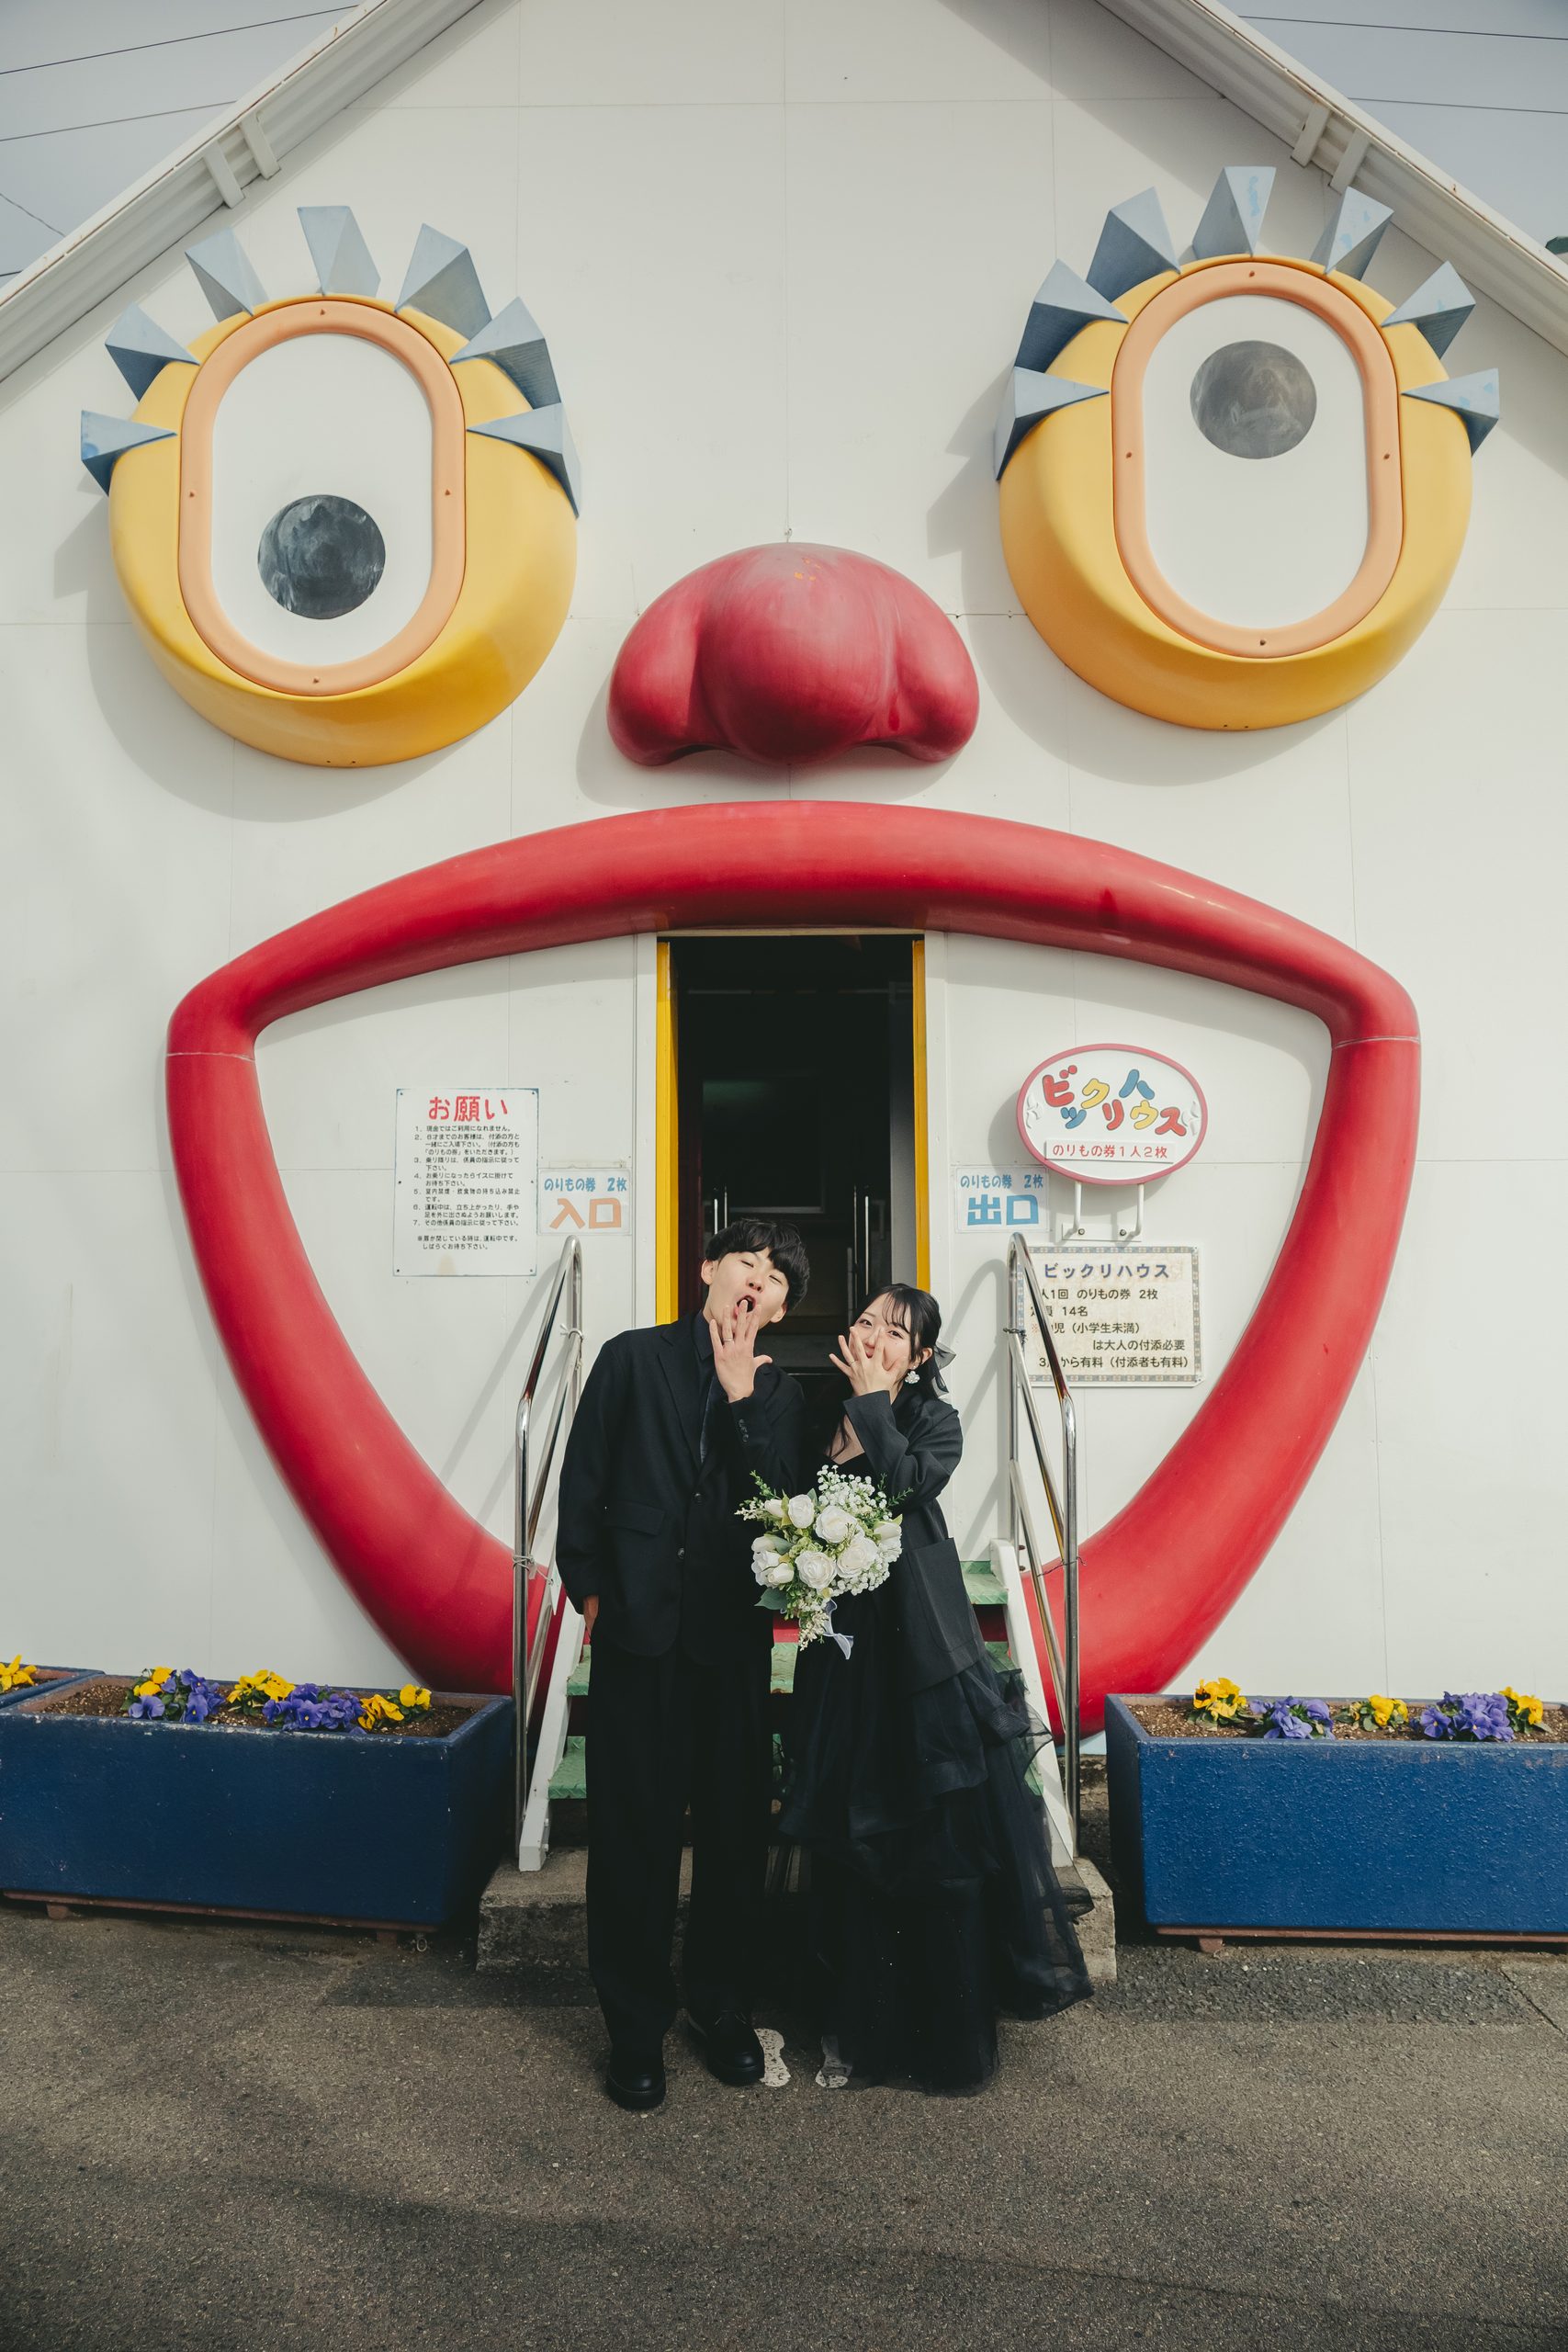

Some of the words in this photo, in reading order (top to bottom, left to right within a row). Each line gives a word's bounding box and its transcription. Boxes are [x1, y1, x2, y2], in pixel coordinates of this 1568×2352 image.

[428, 1095, 508, 1122] お願い
[1052, 1144, 1168, 1159] のりもの券1人2枚
[544, 1177, 596, 1193] のりもの券
[607, 1177, 627, 1193] 2枚
[960, 1174, 1012, 1189] のりもの券
[1023, 1173, 1044, 1189] 2枚
[549, 1197, 622, 1229] 入口
[967, 1193, 1040, 1227] 出口
[1044, 1262, 1170, 1280] ビックリハウス
[1076, 1288, 1132, 1301] のりもの券
[1138, 1288, 1159, 1301] 2枚
[1062, 1305, 1089, 1317] 14名
[1092, 1339, 1186, 1351] は大人の付添必要
[1038, 1355, 1189, 1369] 3から有料（付添者も有料）
